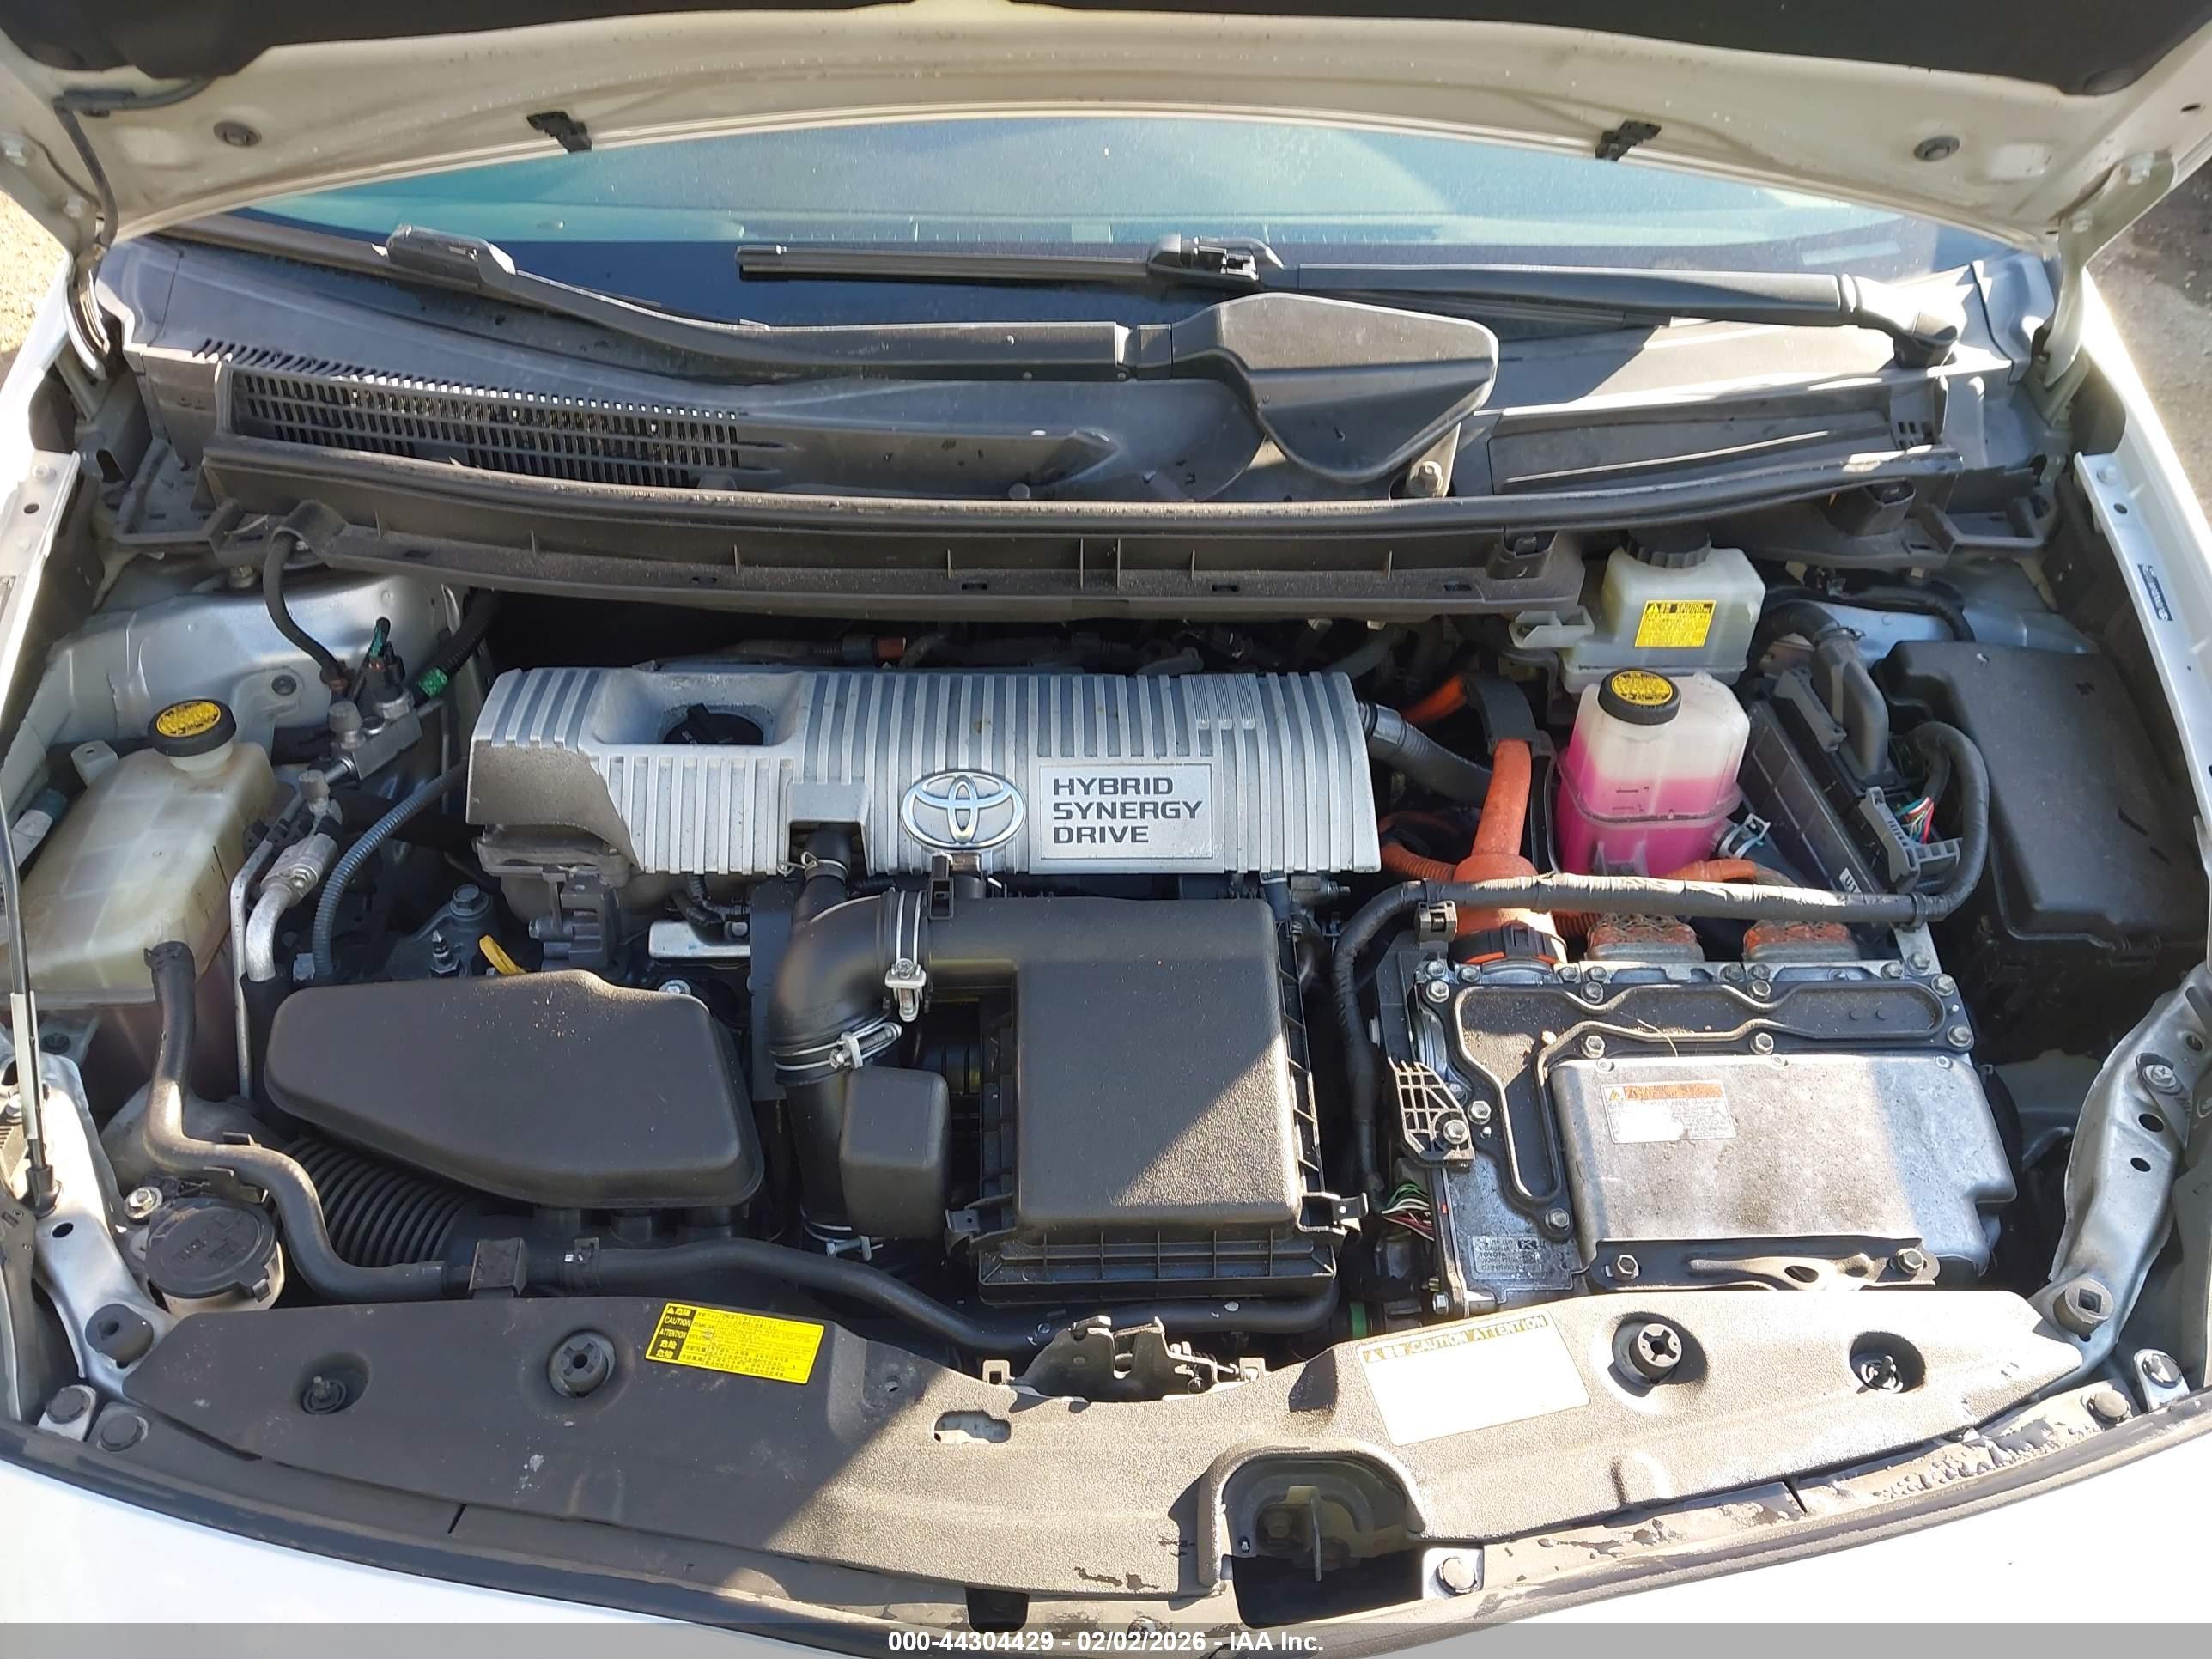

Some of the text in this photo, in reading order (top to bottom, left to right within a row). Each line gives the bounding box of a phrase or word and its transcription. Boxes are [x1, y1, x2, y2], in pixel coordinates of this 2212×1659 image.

[1053, 777, 1173, 796] HYBRID
[1053, 800, 1203, 820] SYNERGY
[1053, 825, 1149, 844] DRIVE
[665, 1316, 692, 1327] CAUTION
[659, 1328, 688, 1339] ATTENTION
[1412, 1331, 1468, 1352] CAUTION
[1473, 1315, 1547, 1341] ATTENTION
